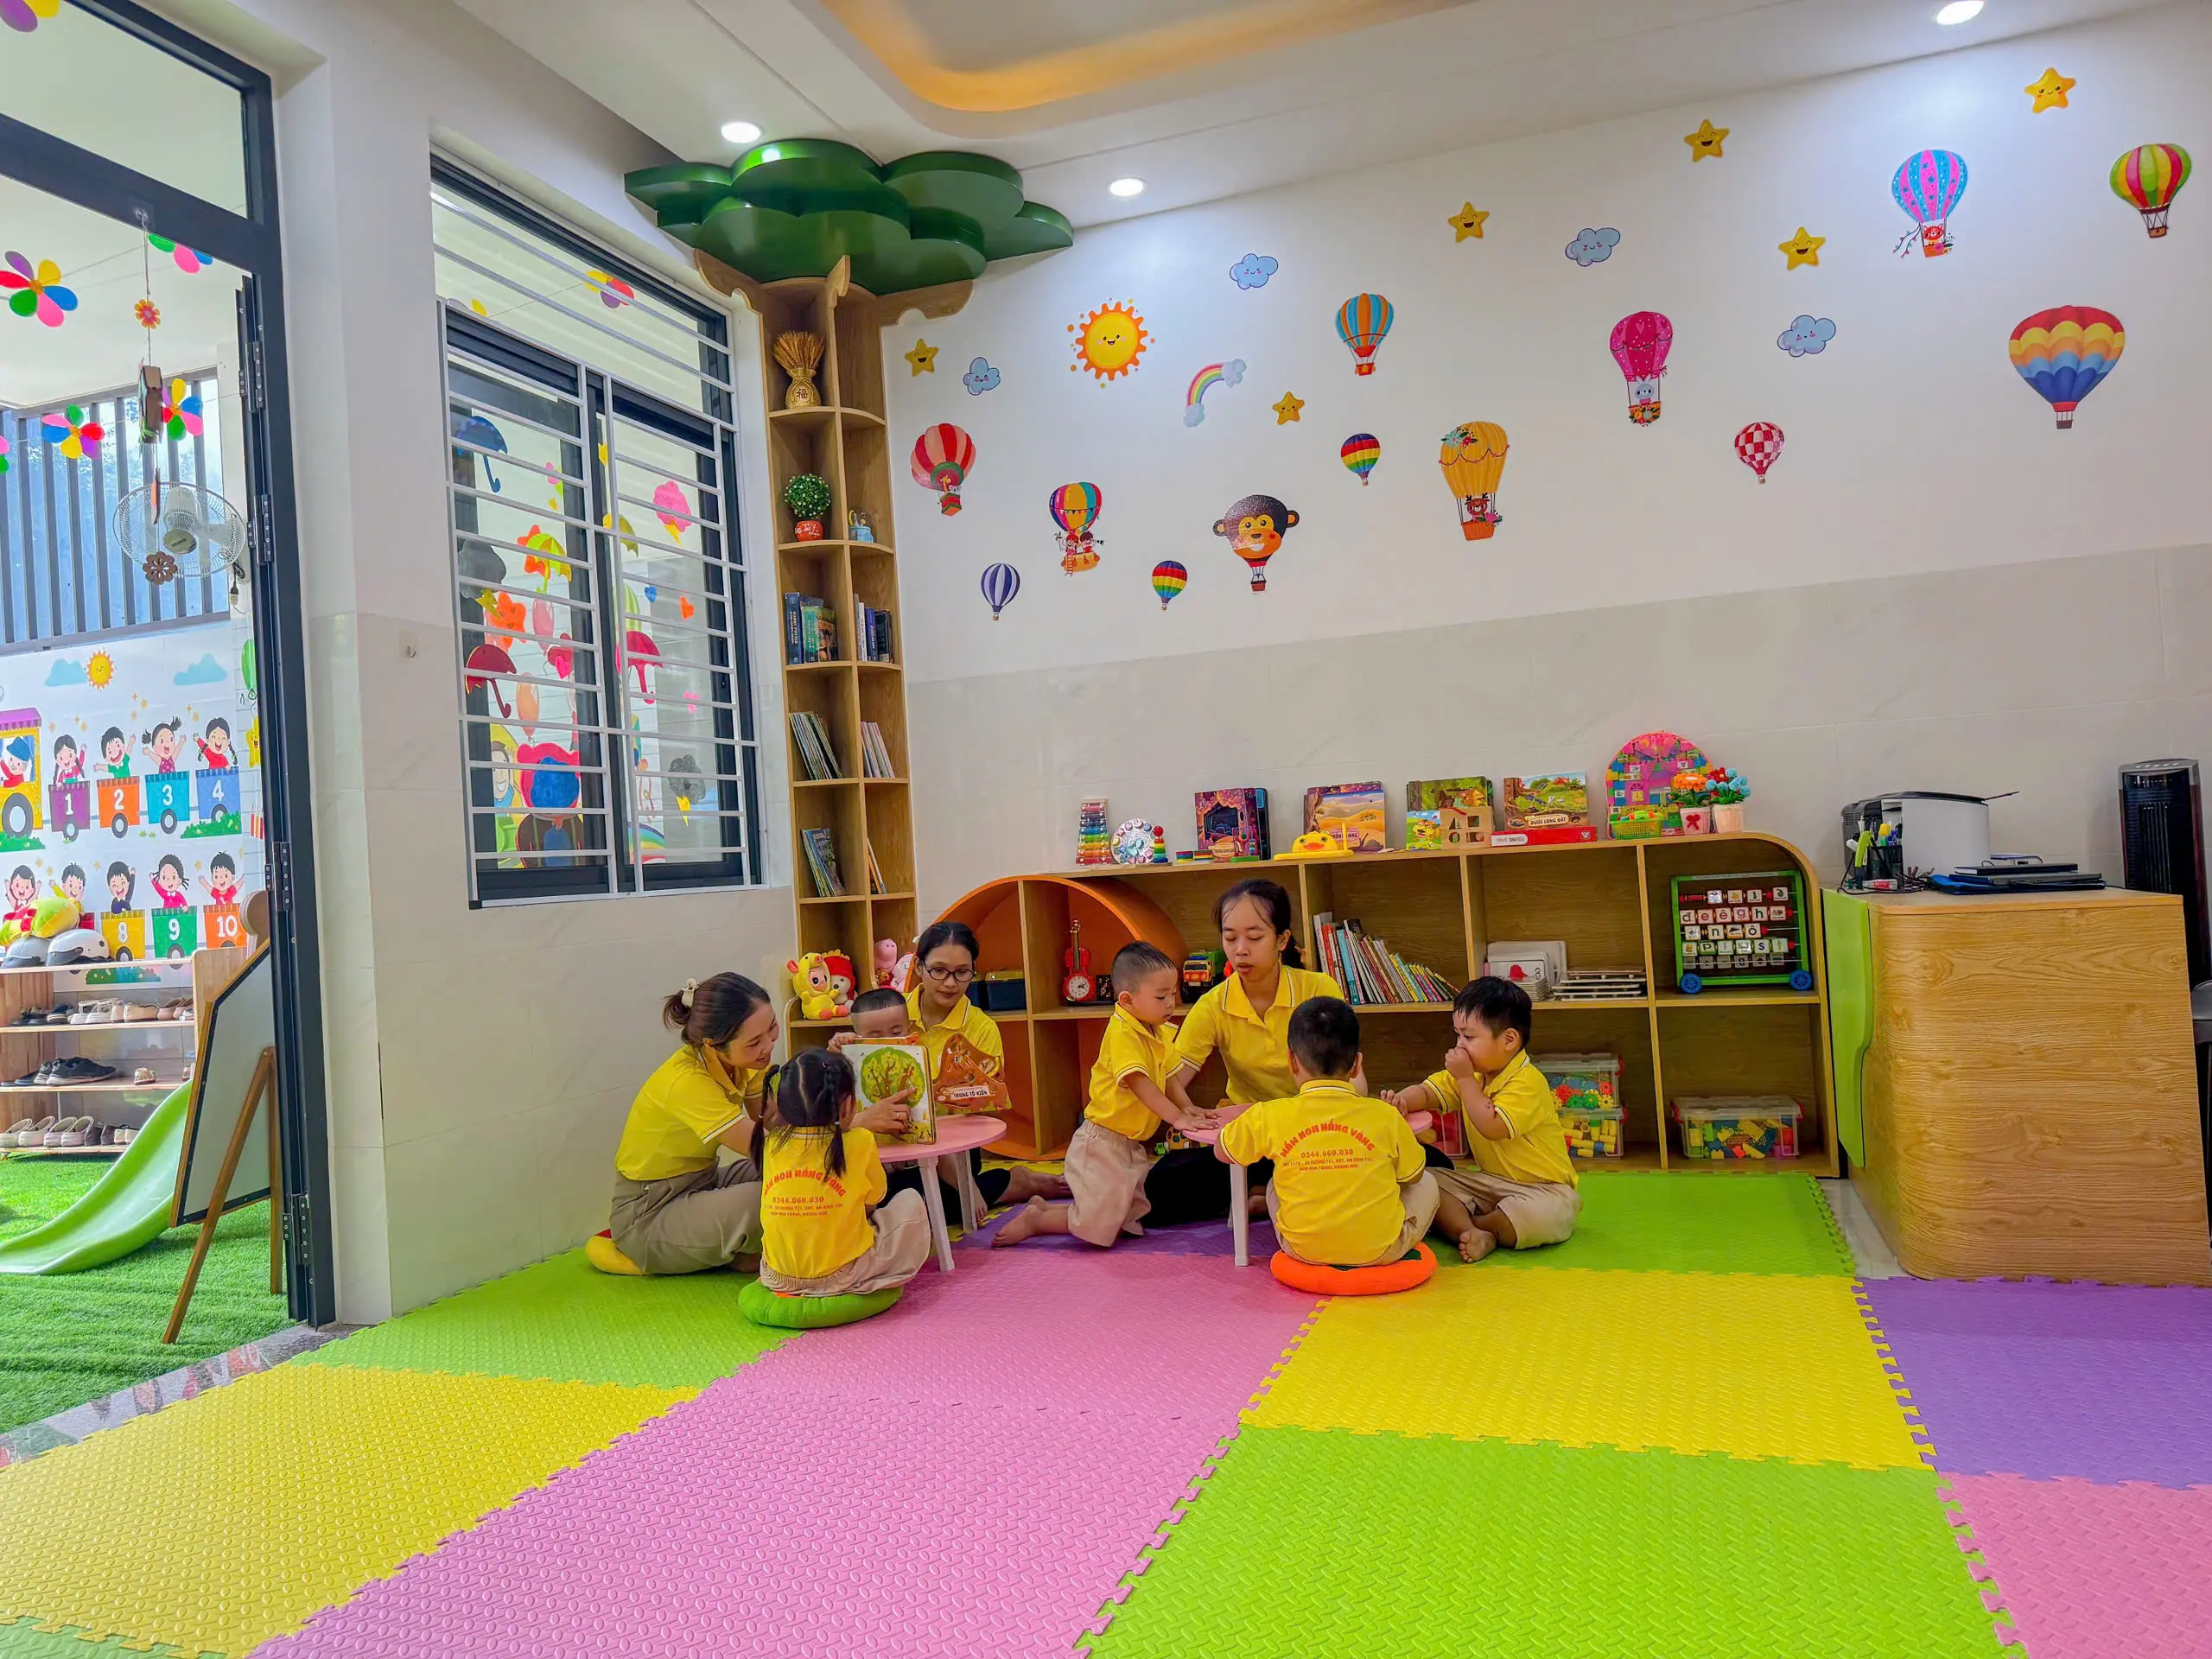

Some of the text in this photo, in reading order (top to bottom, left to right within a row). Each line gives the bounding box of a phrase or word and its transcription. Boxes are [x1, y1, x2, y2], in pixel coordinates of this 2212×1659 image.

[113, 788, 124, 810] 2
[162, 784, 173, 805] 3
[212, 779, 224, 802] 4
[65, 793, 73, 815] 1
[1737, 909, 1745, 919] g
[1756, 909, 1764, 919] h
[118, 921, 128, 944] 8
[168, 918, 180, 940] 9
[217, 914, 238, 938] 10
[1712, 928, 1719, 937] n
[1298, 1125, 1319, 1141] NON
[1351, 1128, 1376, 1151] VÀNG
[1300, 1148, 1354, 1158] 0344.060.030
